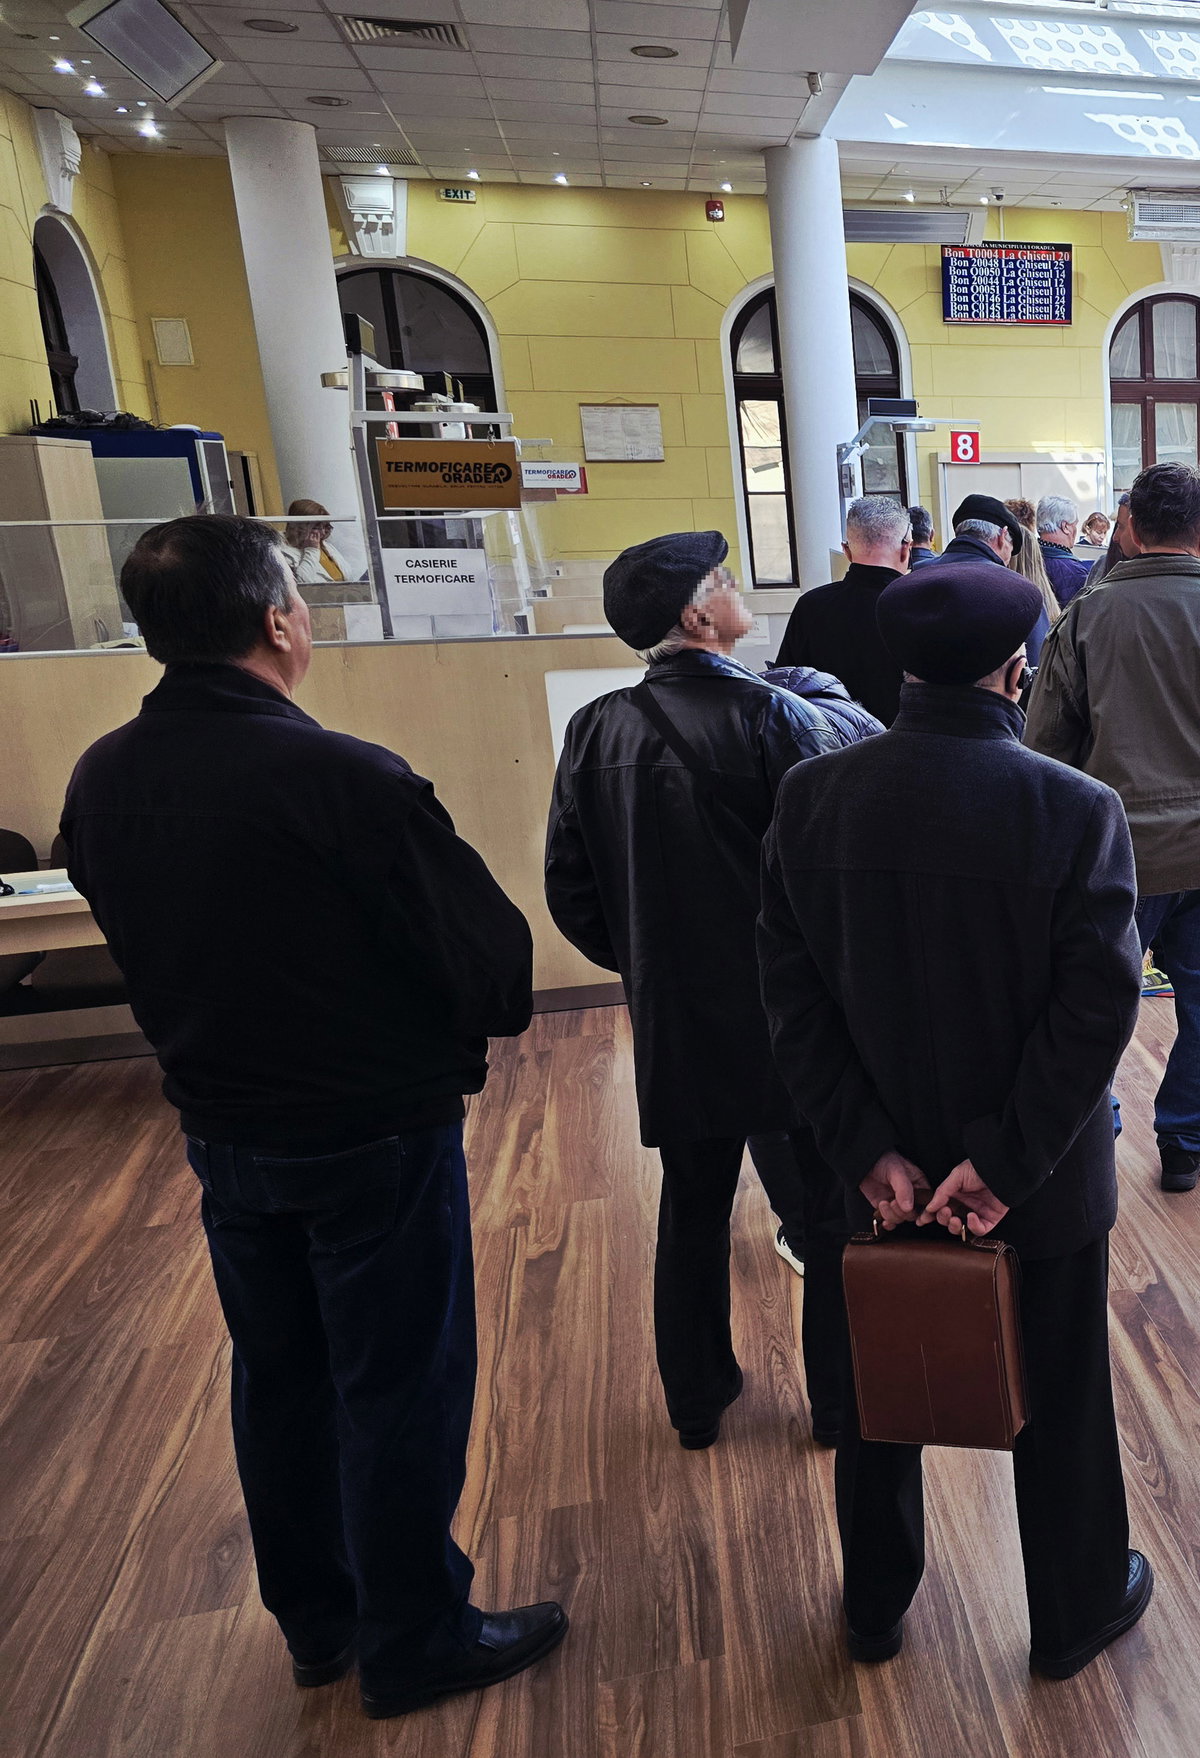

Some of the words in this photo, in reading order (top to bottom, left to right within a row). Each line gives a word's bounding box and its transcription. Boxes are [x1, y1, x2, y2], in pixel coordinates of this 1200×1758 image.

[445, 189, 470, 199] EXIT
[945, 248, 964, 257] Bon
[968, 248, 998, 259] T0004
[1002, 250, 1014, 260] La
[1058, 252, 1070, 261] 20
[951, 257, 968, 267] Bon
[972, 258, 998, 267] 20048
[1002, 260, 1014, 268] La
[1054, 261, 1064, 269] 25
[949, 266, 967, 275] Bon
[1004, 269, 1015, 277] La
[1056, 270, 1065, 278] 14
[951, 276, 969, 284] Bon
[972, 277, 999, 285] 20044
[1002, 277, 1014, 286] La
[1055, 279, 1064, 287] 12
[950, 284, 968, 293] Bon
[1004, 286, 1015, 295] La
[1056, 288, 1065, 296] 10
[951, 294, 969, 302] Bon
[971, 294, 1000, 302] C0146
[1004, 295, 1015, 303] La
[951, 303, 969, 311] Bon
[971, 303, 1000, 312] C0145
[1004, 304, 1015, 312] La
[1055, 305, 1065, 313] 26
[957, 434, 974, 461] 8
[386, 461, 492, 473] TERMOFICARE
[442, 473, 502, 484] ORADEA
[405, 559, 458, 568] CASIERIE
[394, 574, 475, 584] TERMOFICARE
